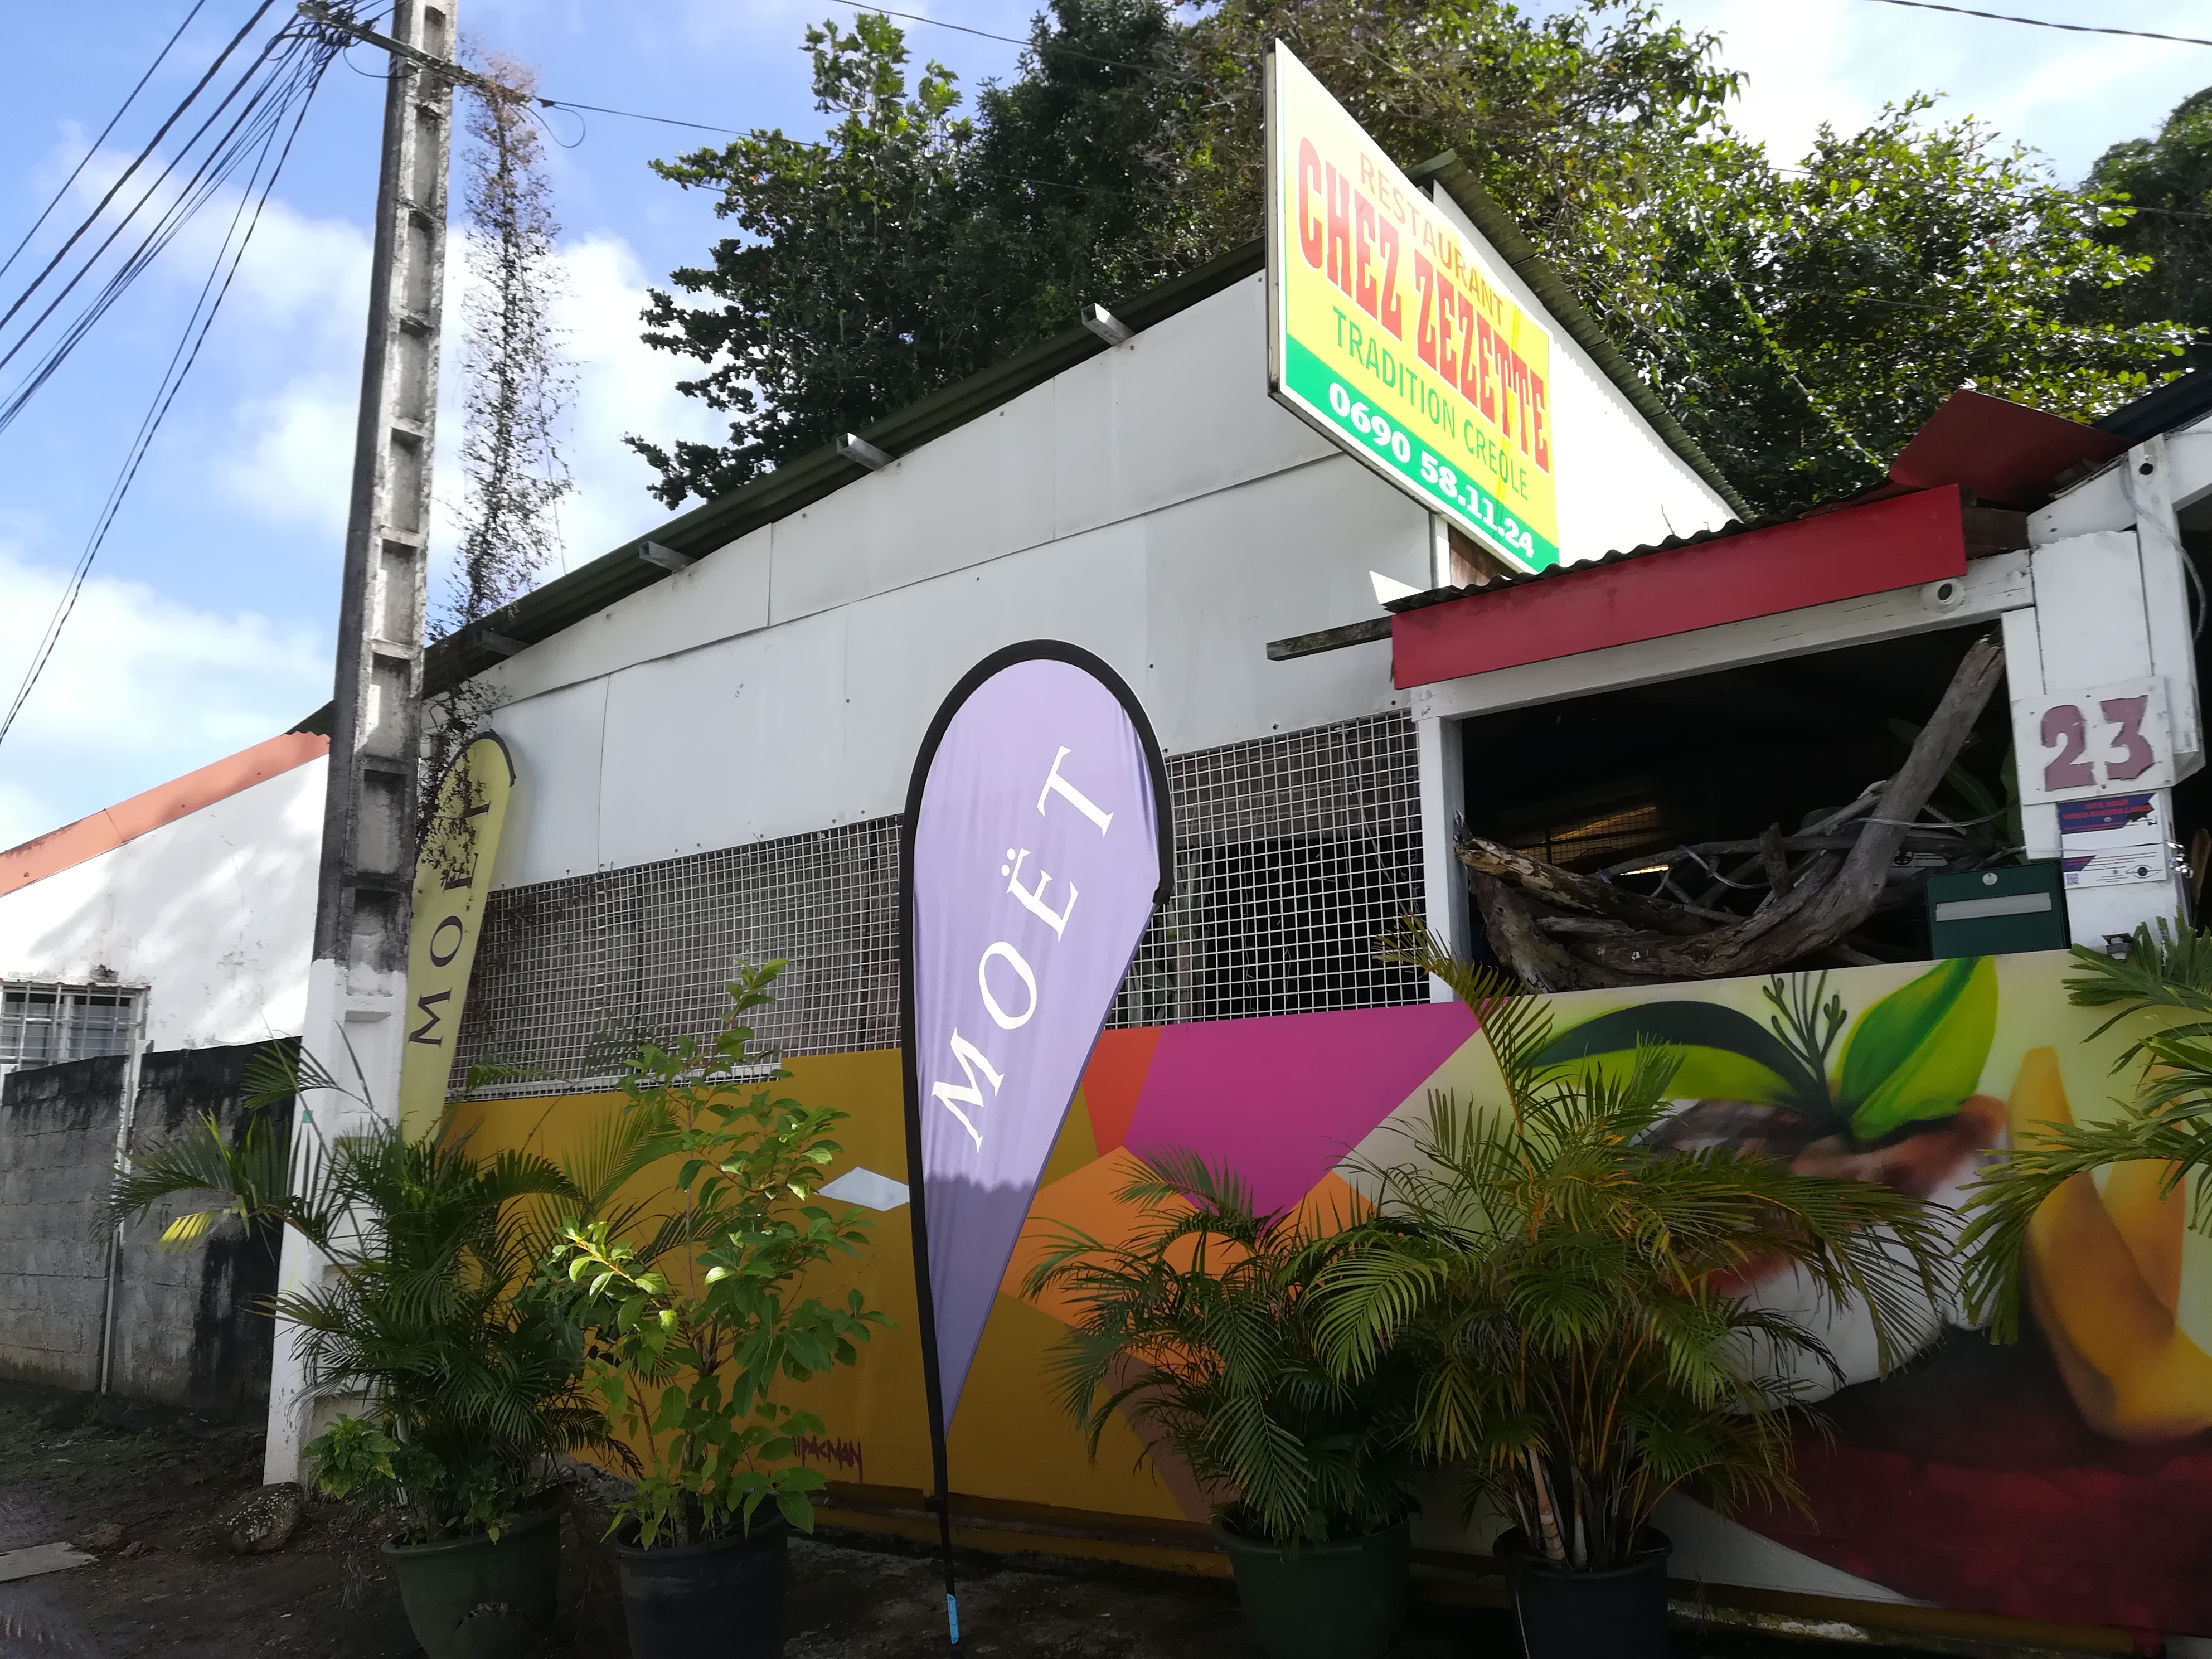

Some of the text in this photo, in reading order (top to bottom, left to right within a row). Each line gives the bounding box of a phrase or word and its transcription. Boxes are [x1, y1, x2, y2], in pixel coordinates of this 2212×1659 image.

[1299, 137, 1550, 474] CHEZ ZEZETTE
[1360, 151, 1503, 326] RESTAURANT
[1329, 382, 1535, 559] 0690 58.11.24
[1333, 305, 1528, 501] TRADITION CREOLE
[2040, 694, 2155, 792] 23
[930, 745, 1114, 1154] MOËT
